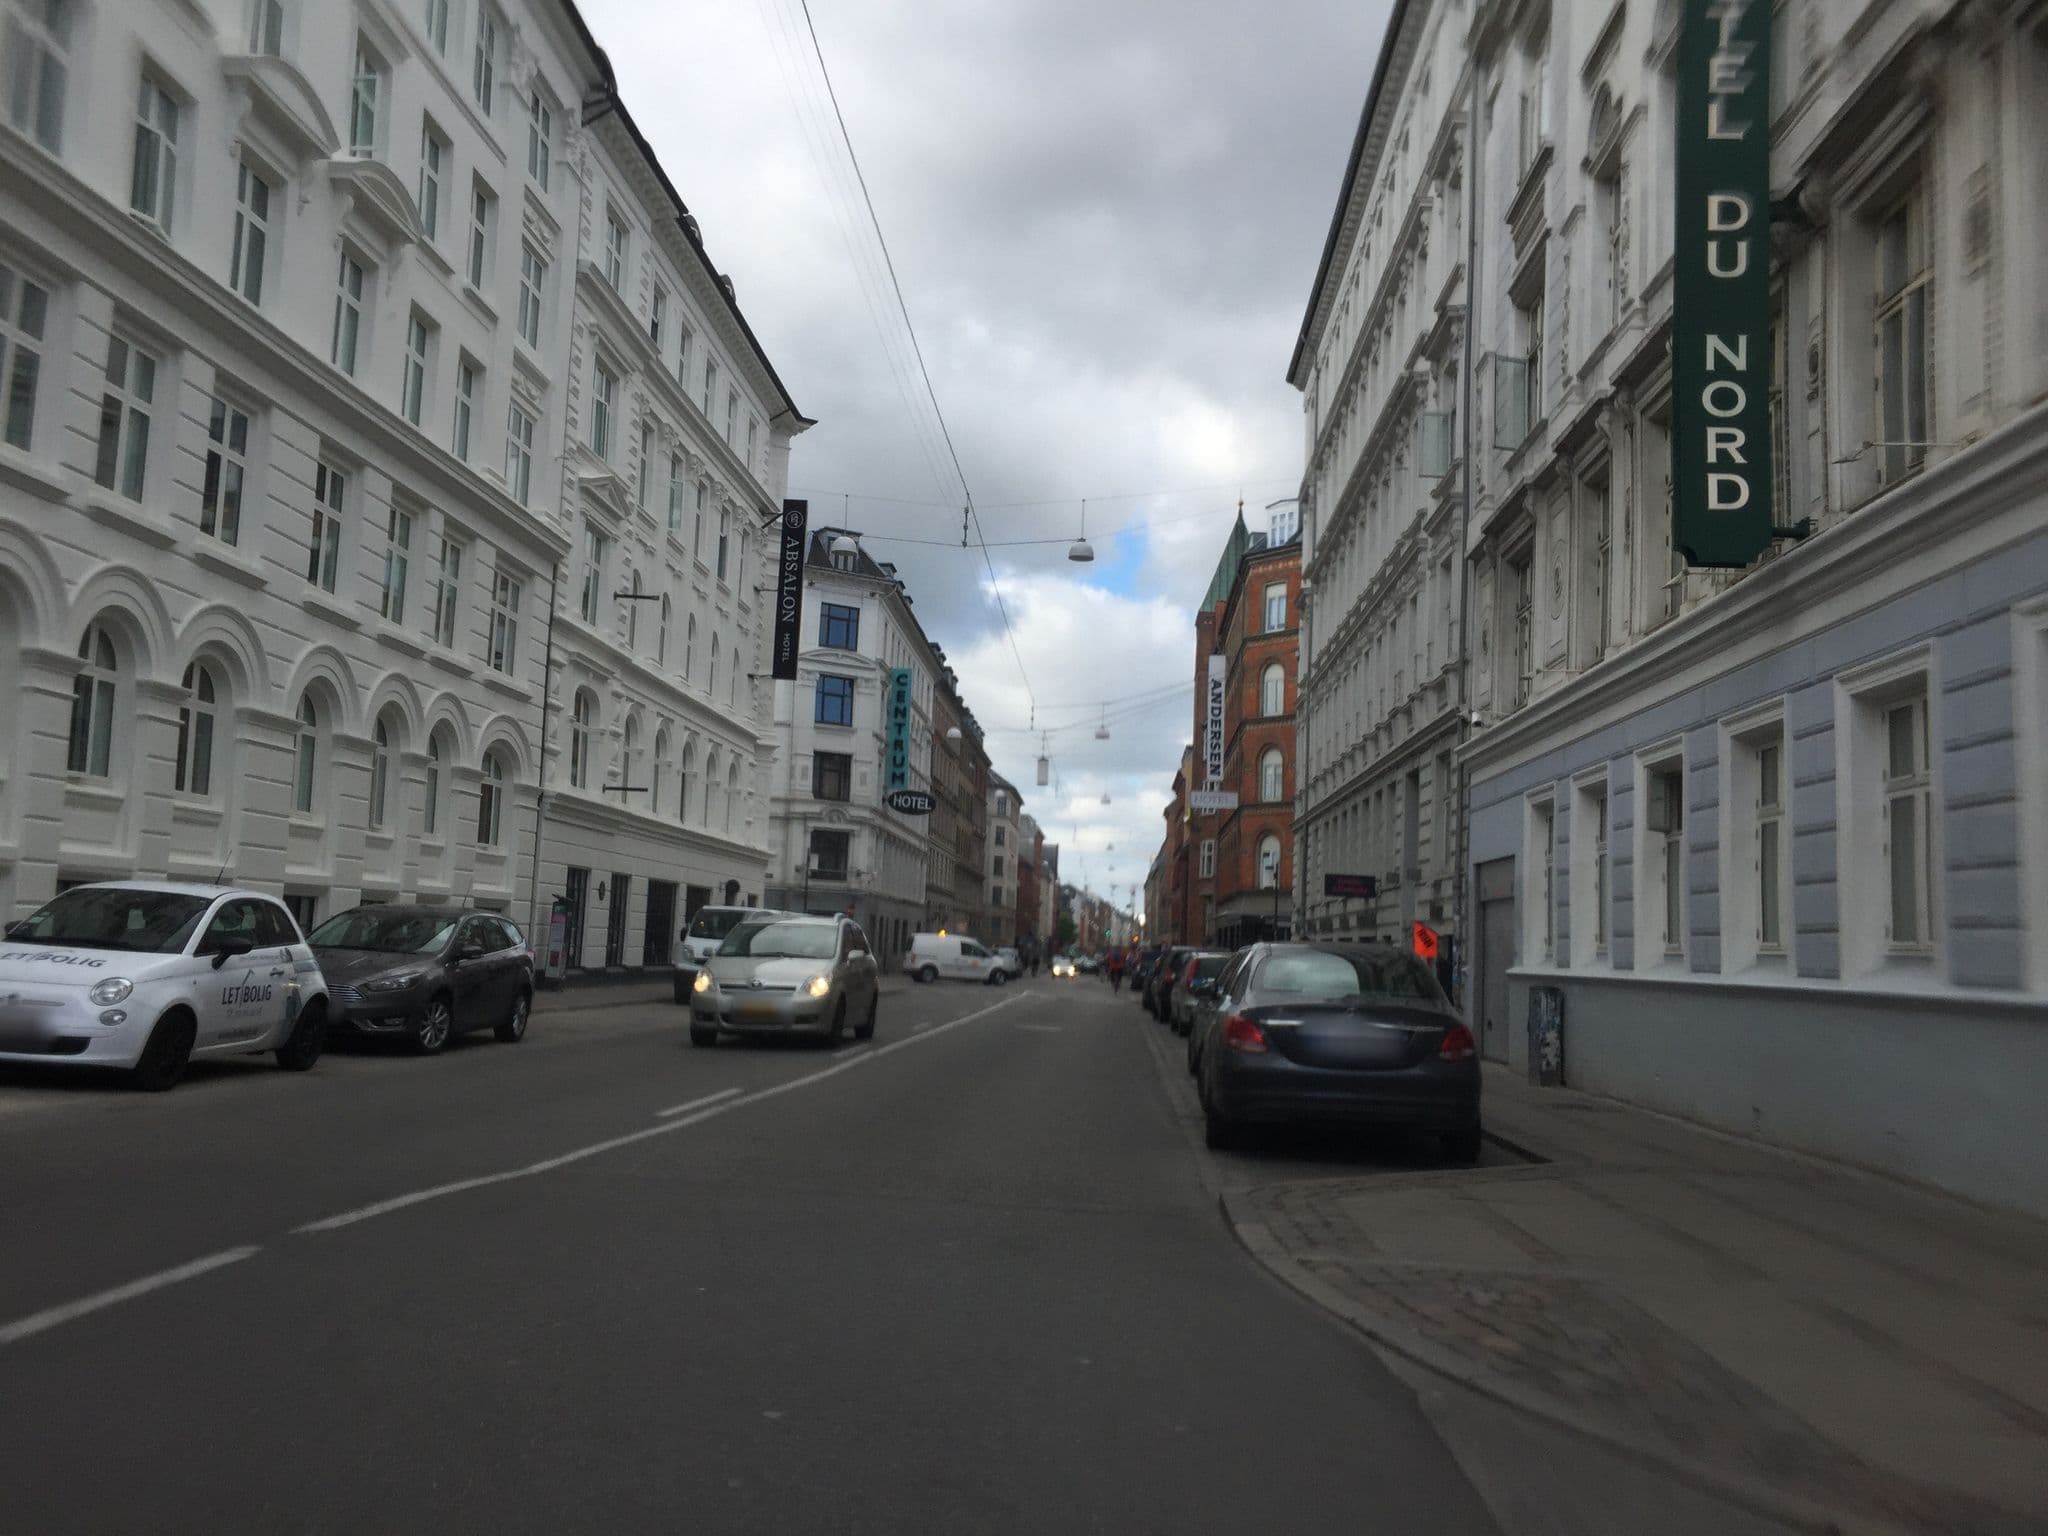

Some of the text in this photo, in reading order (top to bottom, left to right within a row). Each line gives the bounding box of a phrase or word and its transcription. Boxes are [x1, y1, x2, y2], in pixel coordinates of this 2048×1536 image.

[1706, 194, 1752, 279] DU
[1701, 334, 1752, 512] NORD
[781, 536, 800, 662] ABSALON HOTEL
[891, 673, 909, 785] CENTRUM
[1209, 678, 1222, 777] ANDERSEN
[893, 795, 932, 810] HOTEL
